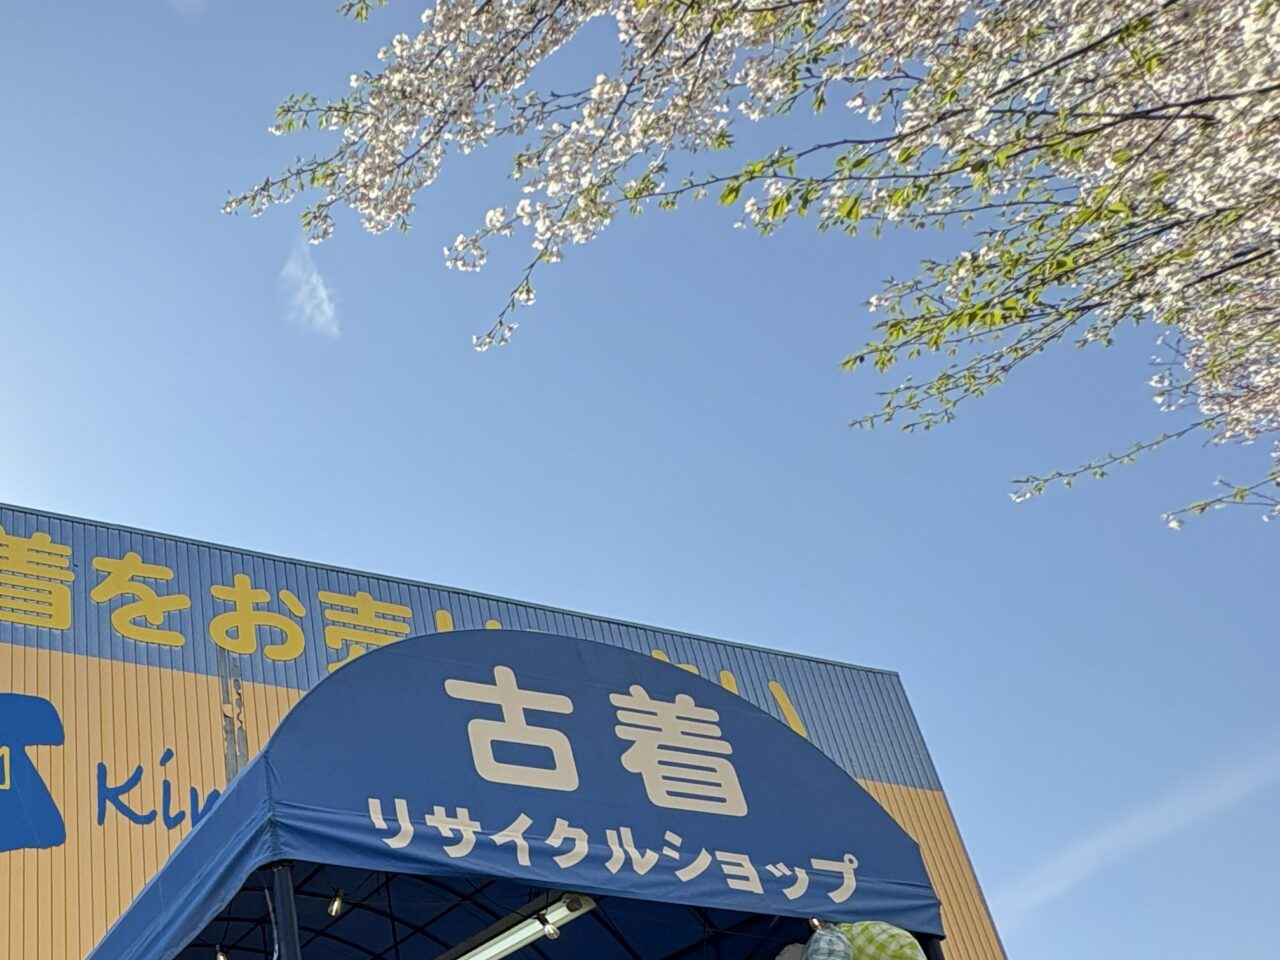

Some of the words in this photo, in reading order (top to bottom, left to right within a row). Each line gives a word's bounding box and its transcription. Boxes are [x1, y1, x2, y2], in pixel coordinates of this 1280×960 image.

[444, 665, 749, 818] 古着
[367, 797, 859, 904] リサイクルショップ
